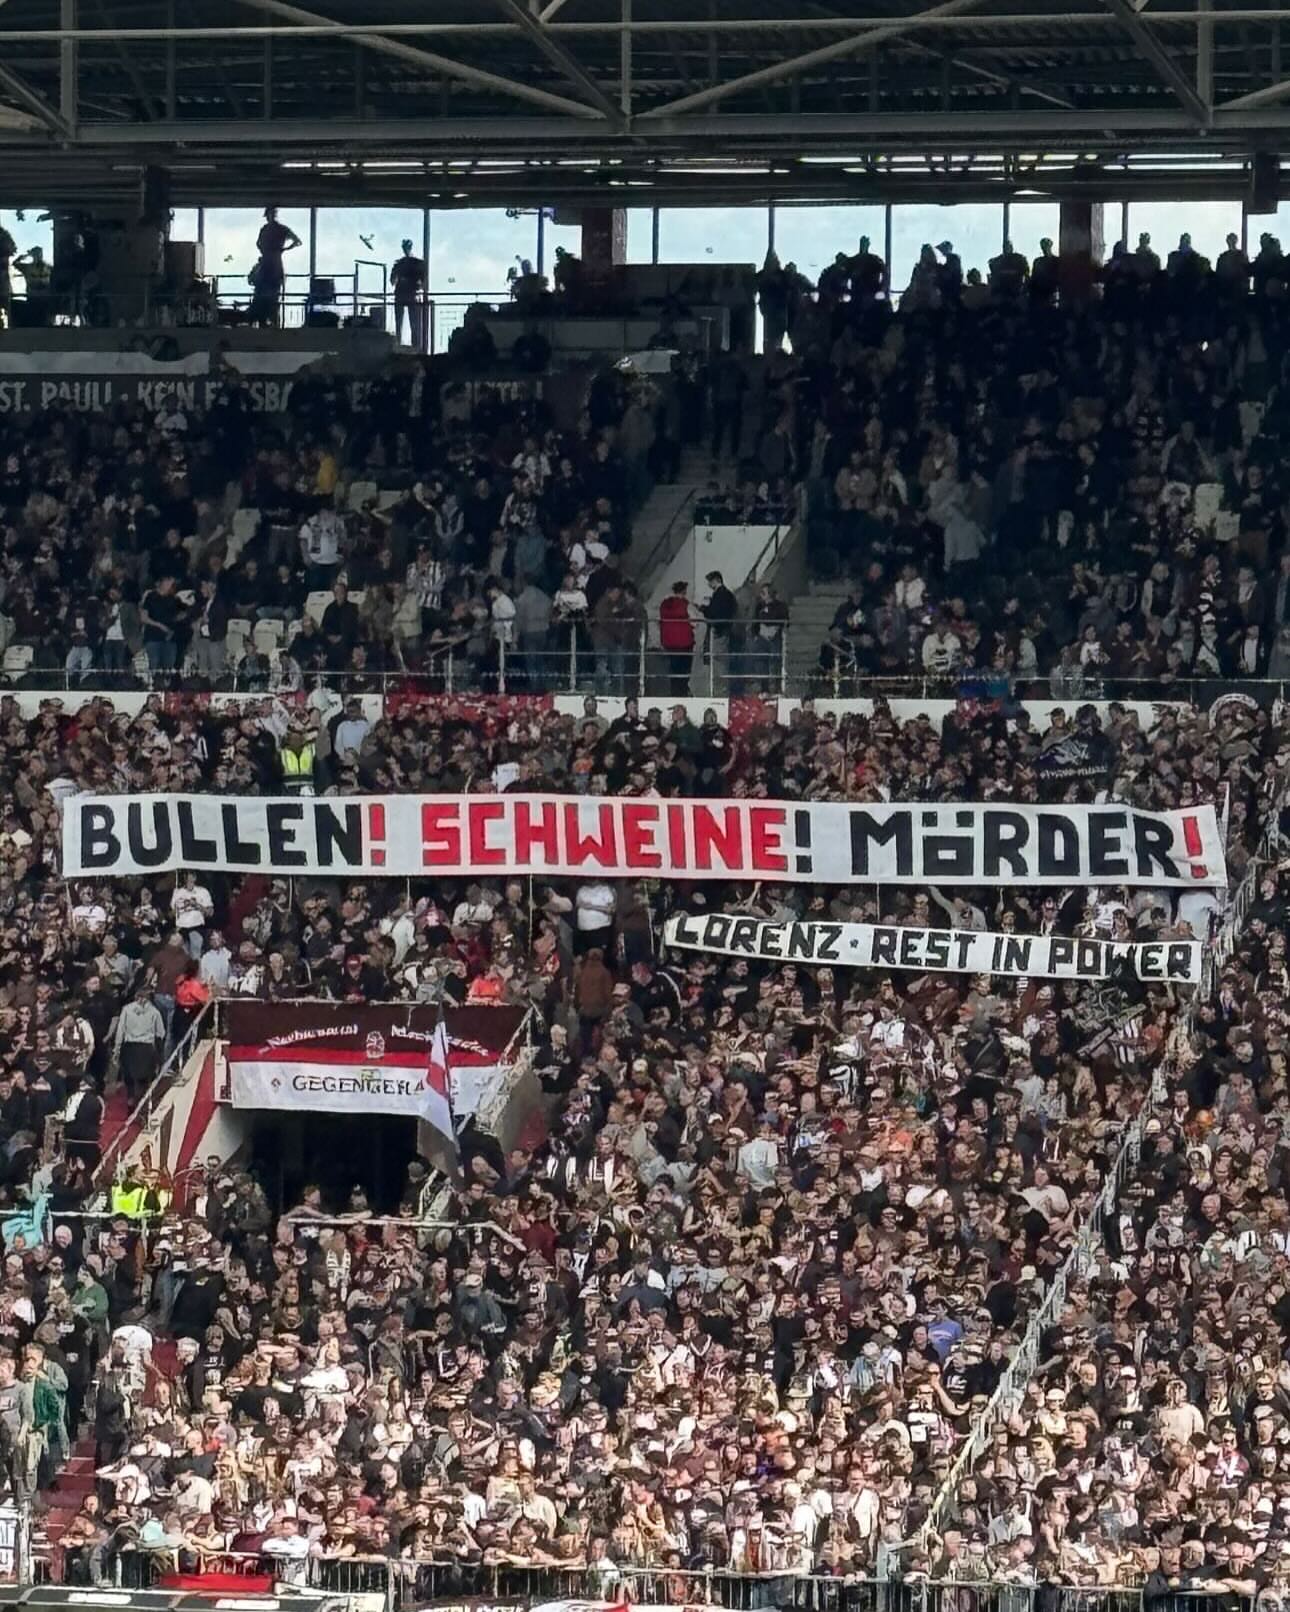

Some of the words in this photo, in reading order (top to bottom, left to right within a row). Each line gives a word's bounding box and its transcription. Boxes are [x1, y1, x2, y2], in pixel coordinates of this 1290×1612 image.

[81, 800, 386, 868] BULLEN!
[421, 801, 812, 873] SCHWEINE!
[849, 810, 1208, 879] MÖRDER!
[675, 914, 843, 960] LORENZ
[871, 927, 976, 968] REST
[992, 936, 1032, 972] IN
[1048, 937, 1192, 979] POWER
